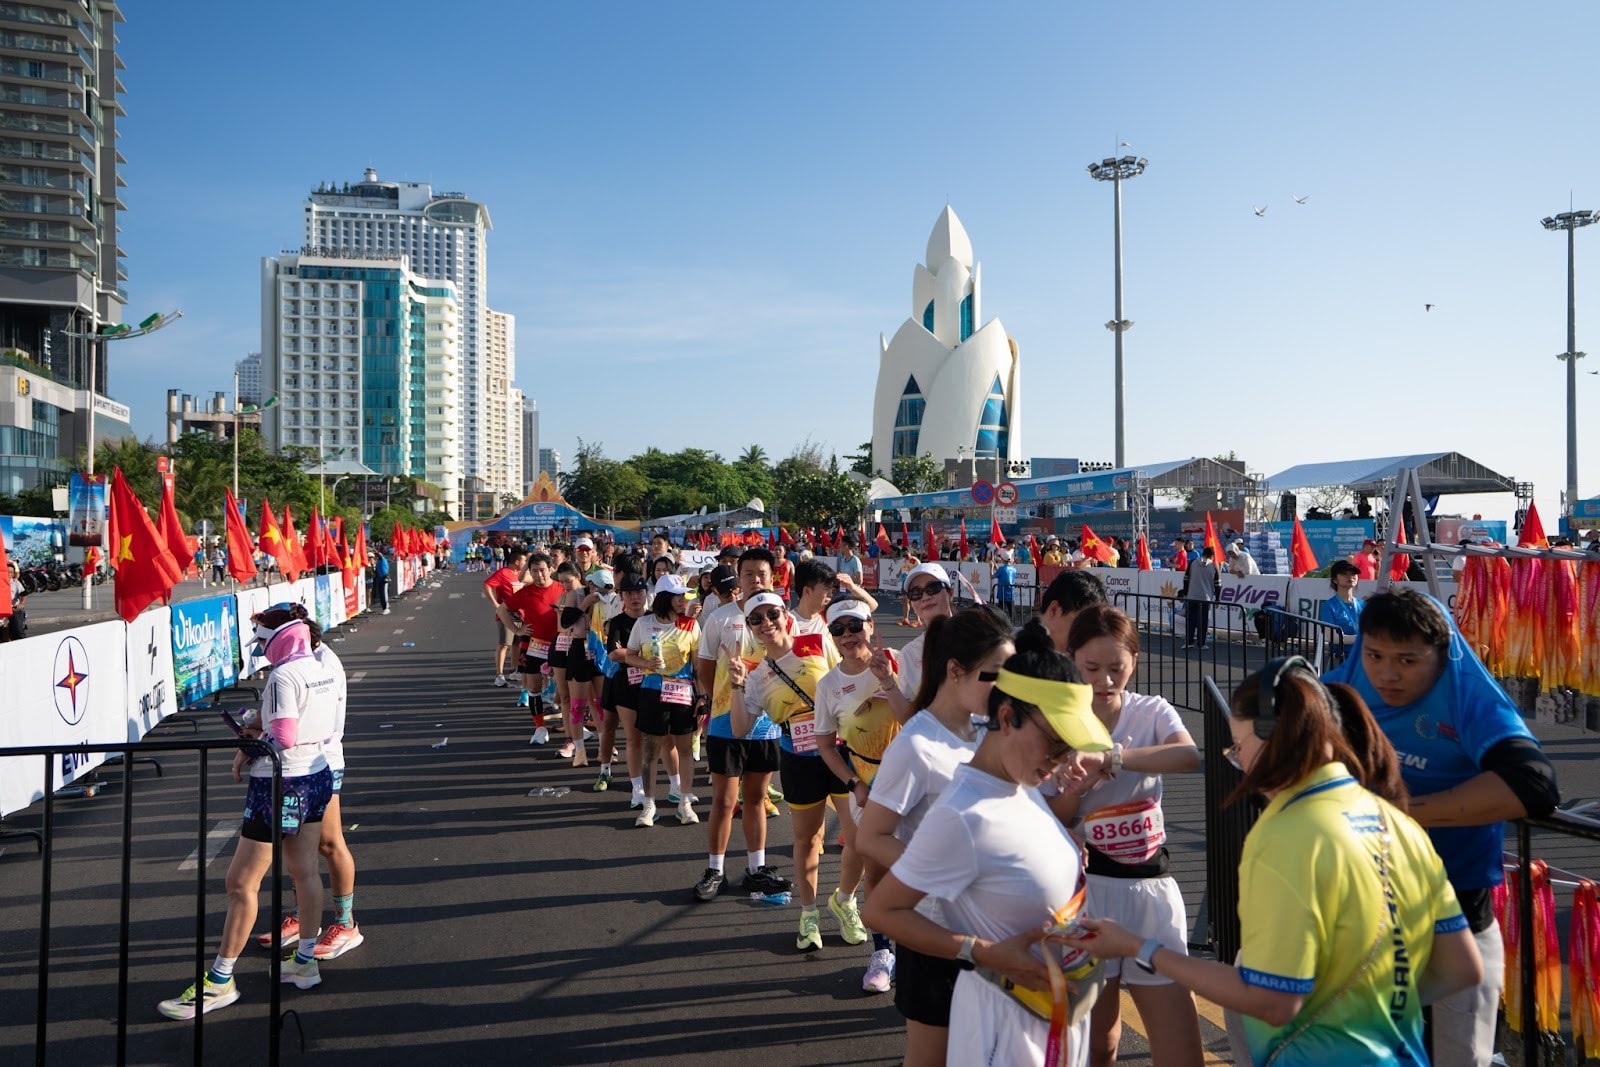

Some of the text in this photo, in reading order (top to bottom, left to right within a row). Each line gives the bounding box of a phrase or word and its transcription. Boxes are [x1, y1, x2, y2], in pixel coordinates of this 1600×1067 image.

[1105, 575, 1130, 586] Cancer
[1219, 584, 1280, 605] eVive
[175, 608, 216, 650] Vikoda
[793, 723, 815, 736] 833
[62, 738, 90, 777] EVN
[1396, 750, 1429, 770] EW
[1092, 816, 1153, 841] 83664
